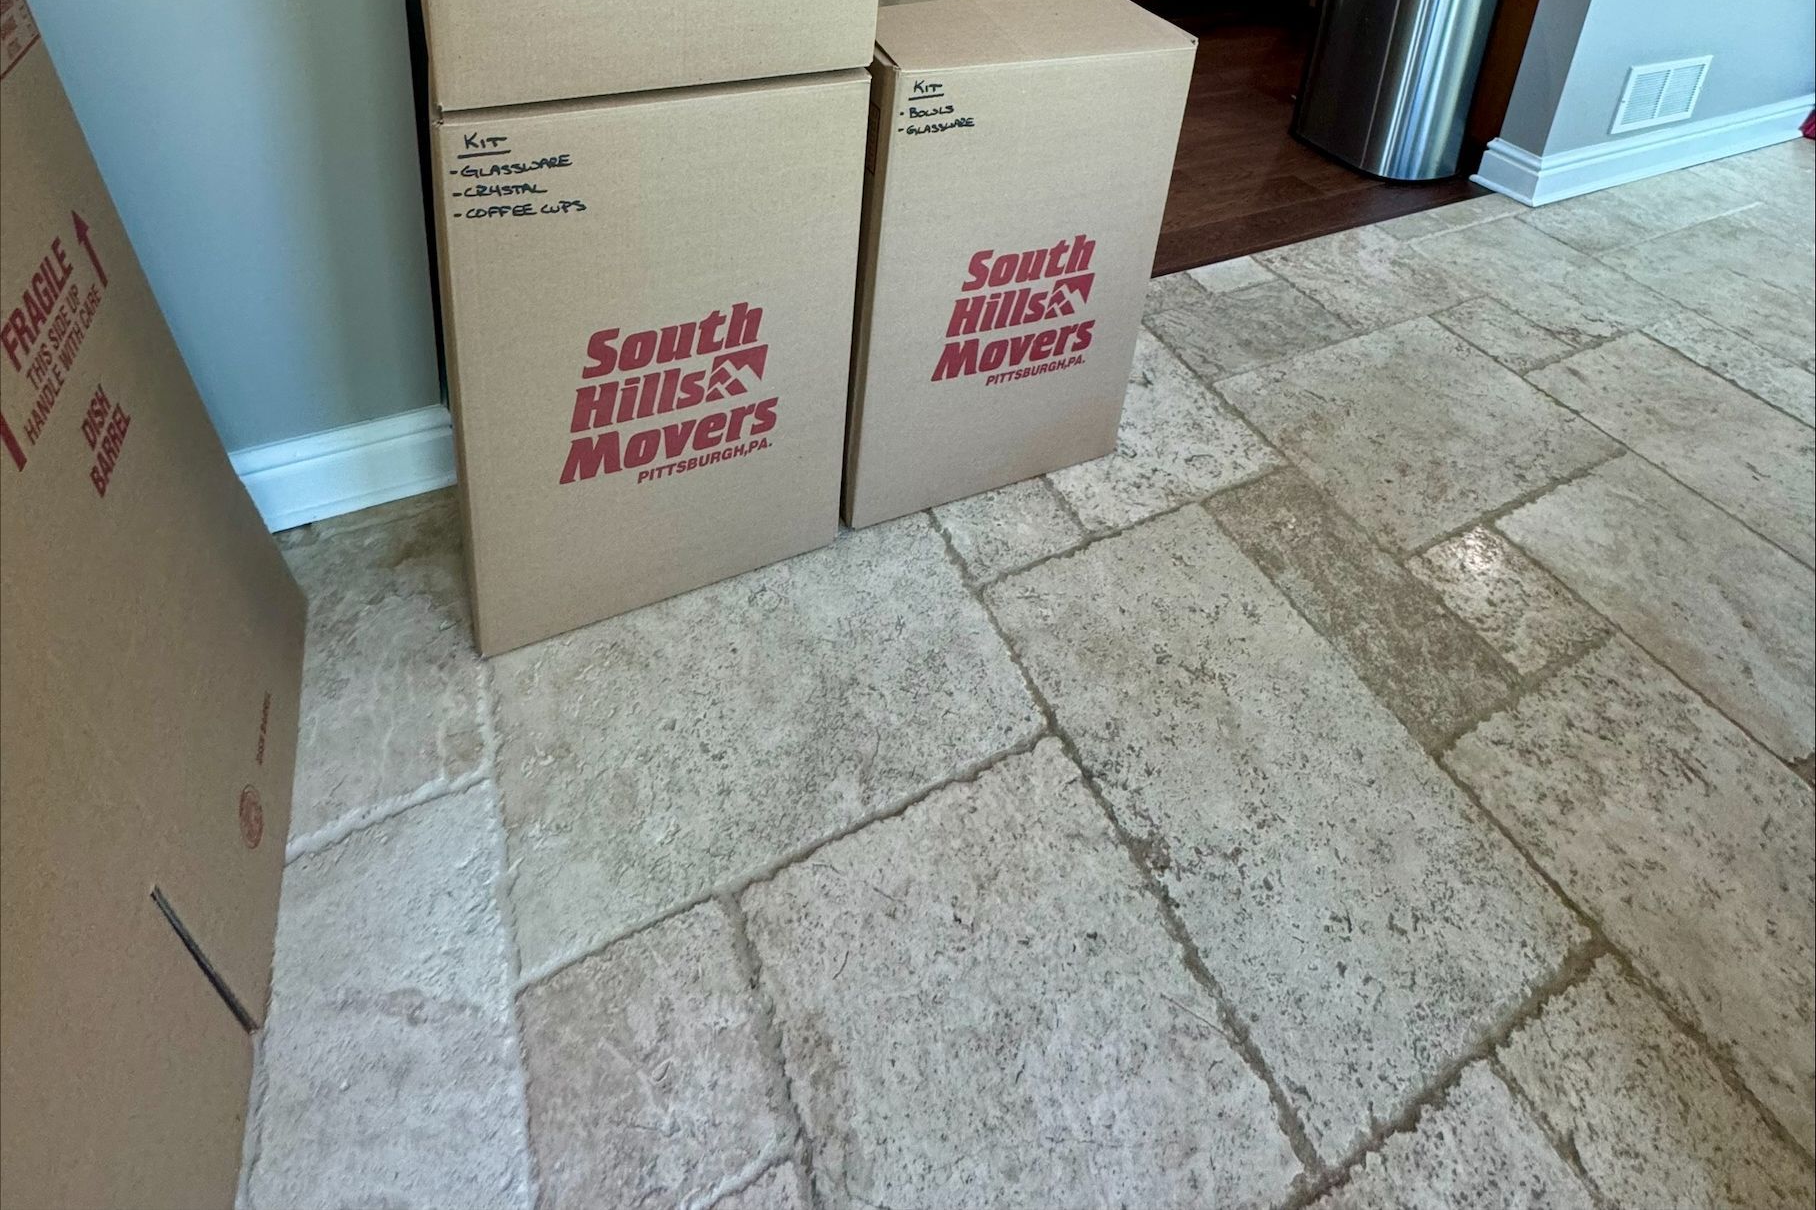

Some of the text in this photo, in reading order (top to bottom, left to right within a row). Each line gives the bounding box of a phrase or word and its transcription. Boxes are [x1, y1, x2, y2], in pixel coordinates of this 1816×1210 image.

[908, 104, 955, 119] BOWLS
[914, 79, 943, 94] KIT
[464, 132, 508, 150] KIT
[541, 199, 588, 214] CUPS
[961, 234, 1096, 292] South
[0, 236, 74, 373] FRAGILE
[26, 283, 80, 390] THIS SIDE UP
[945, 287, 1049, 338] Hills
[23, 283, 102, 446] HANDLE WITH CARE
[582, 301, 763, 380] South
[931, 319, 1096, 382] Movers
[80, 383, 111, 451] DISH
[570, 367, 706, 433] Hills
[89, 402, 132, 498] BARREL
[559, 396, 779, 485] Movers
